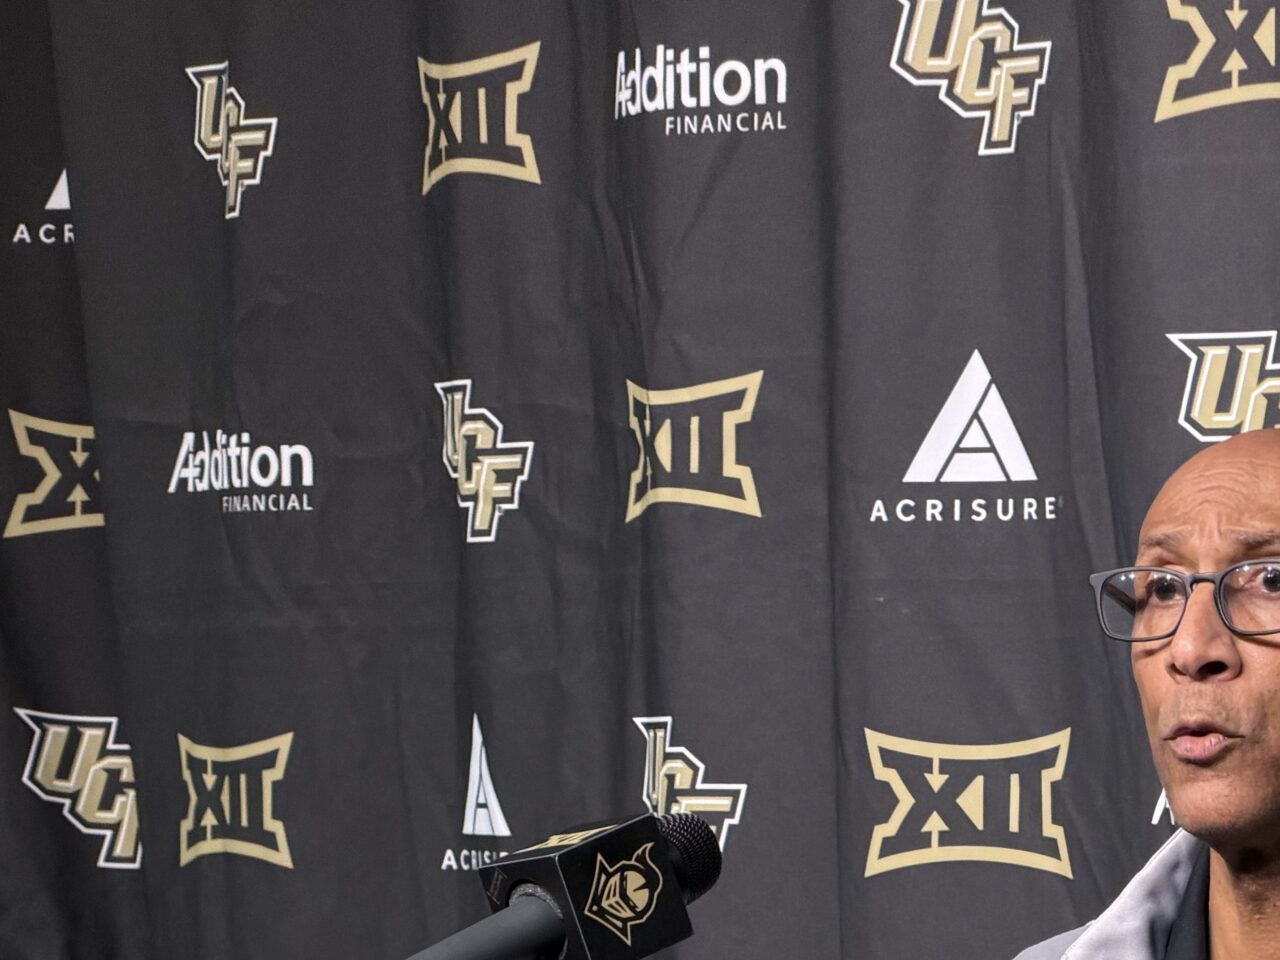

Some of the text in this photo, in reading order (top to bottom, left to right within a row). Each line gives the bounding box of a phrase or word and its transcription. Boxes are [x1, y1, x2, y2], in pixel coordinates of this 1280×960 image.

[417, 40, 541, 195] XII
[615, 43, 787, 120] Addition
[665, 110, 787, 136] FINANCIAL
[185, 60, 278, 220] UCF
[167, 429, 314, 494] Addition
[222, 492, 314, 513] FINANCIAL
[434, 379, 535, 543] UCF
[869, 496, 1057, 522] ACRISURE
[178, 731, 294, 869] XII
[864, 727, 1074, 880] XII
